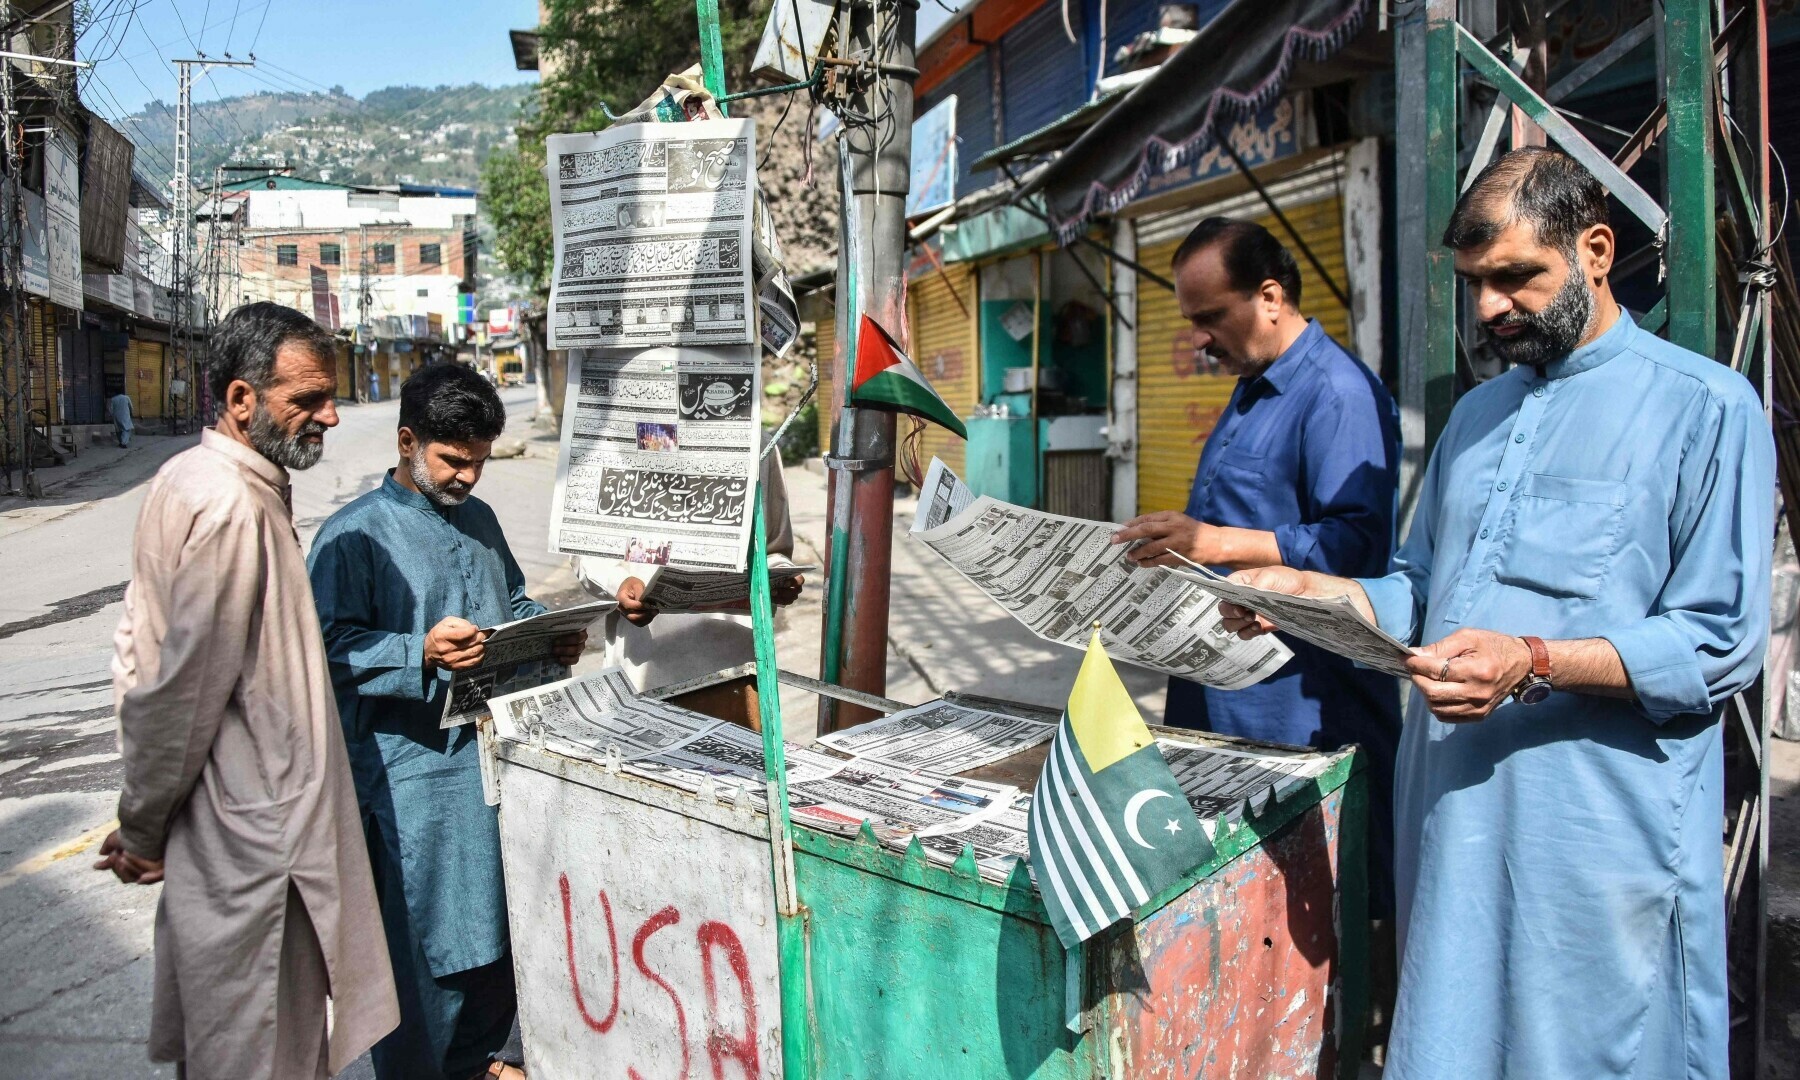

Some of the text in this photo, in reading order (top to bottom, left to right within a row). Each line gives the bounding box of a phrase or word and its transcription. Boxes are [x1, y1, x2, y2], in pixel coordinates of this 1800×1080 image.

[687, 151, 704, 187] نو
[704, 141, 735, 190] صبح
[695, 240, 718, 269] آپریشن
[680, 379, 751, 419] خبریں
[597, 471, 640, 515] اتفاق
[632, 490, 668, 521] جنگ
[691, 484, 727, 522] گھٹنے
[725, 482, 747, 523] بھارت
[558, 870, 760, 1080] USA
